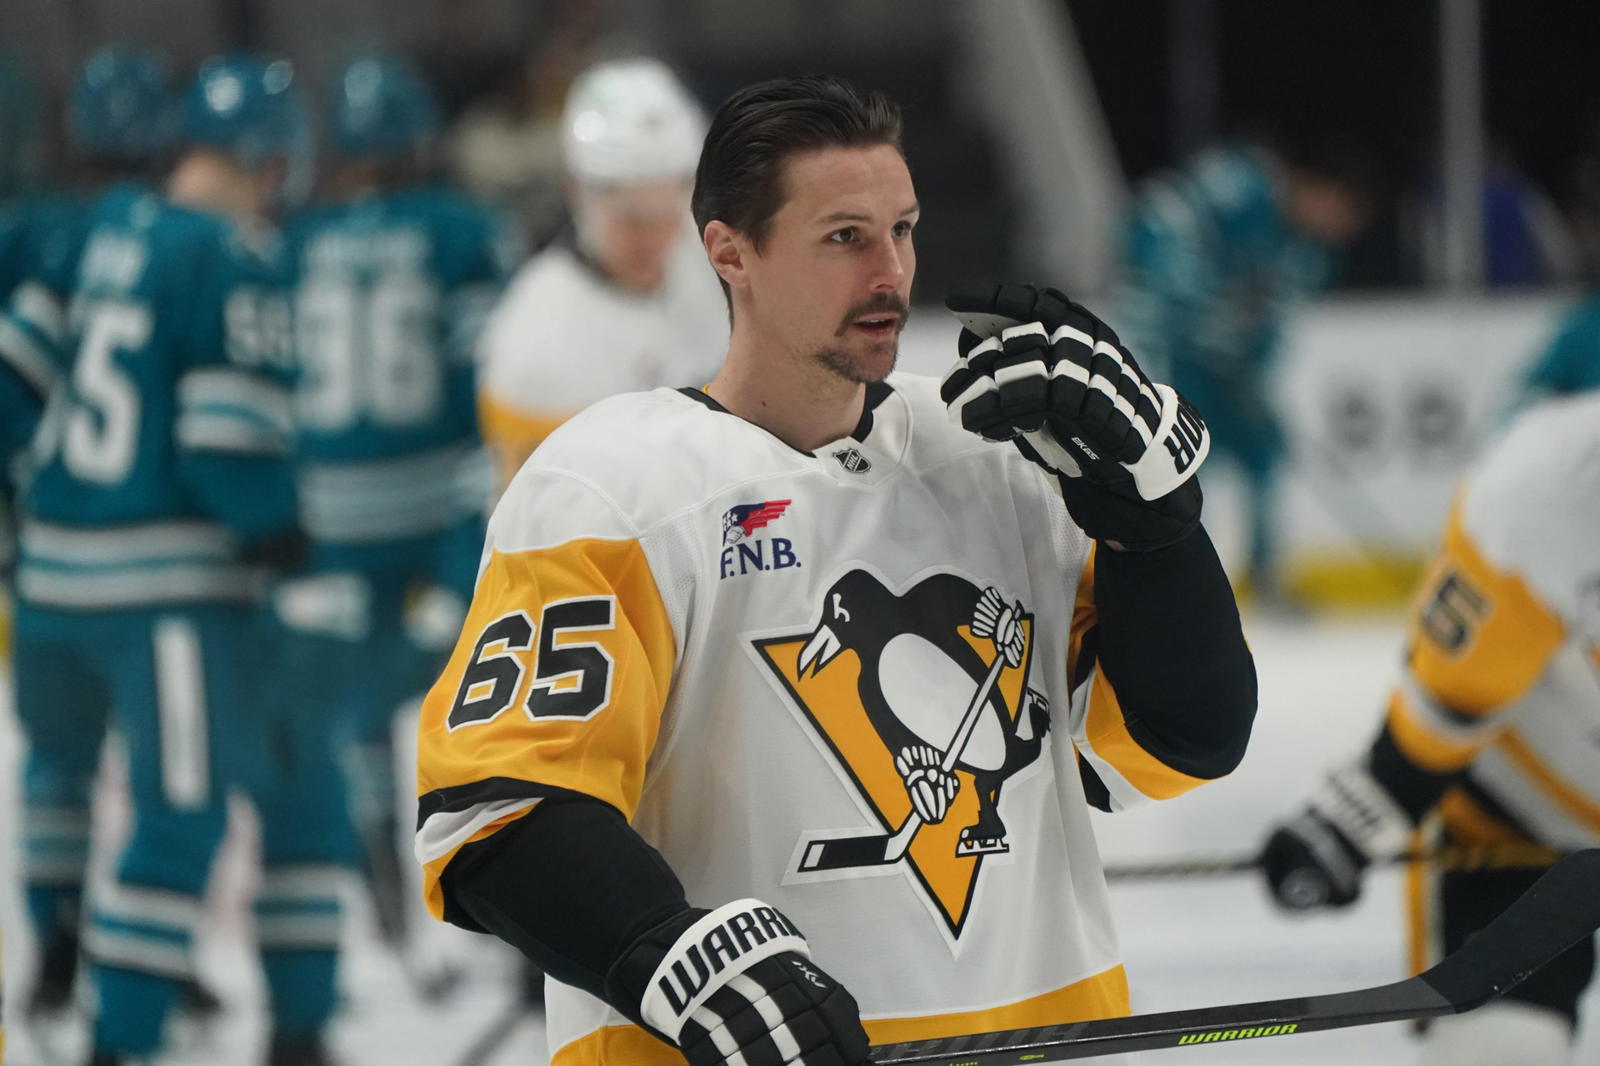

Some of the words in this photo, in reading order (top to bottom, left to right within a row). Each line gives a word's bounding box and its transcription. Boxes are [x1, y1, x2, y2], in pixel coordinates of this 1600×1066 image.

[720, 537, 802, 580] F.N.B.
[445, 594, 617, 734] 65
[658, 906, 807, 1018] WARRI
[1178, 1023, 1298, 1045] WARRIOR
